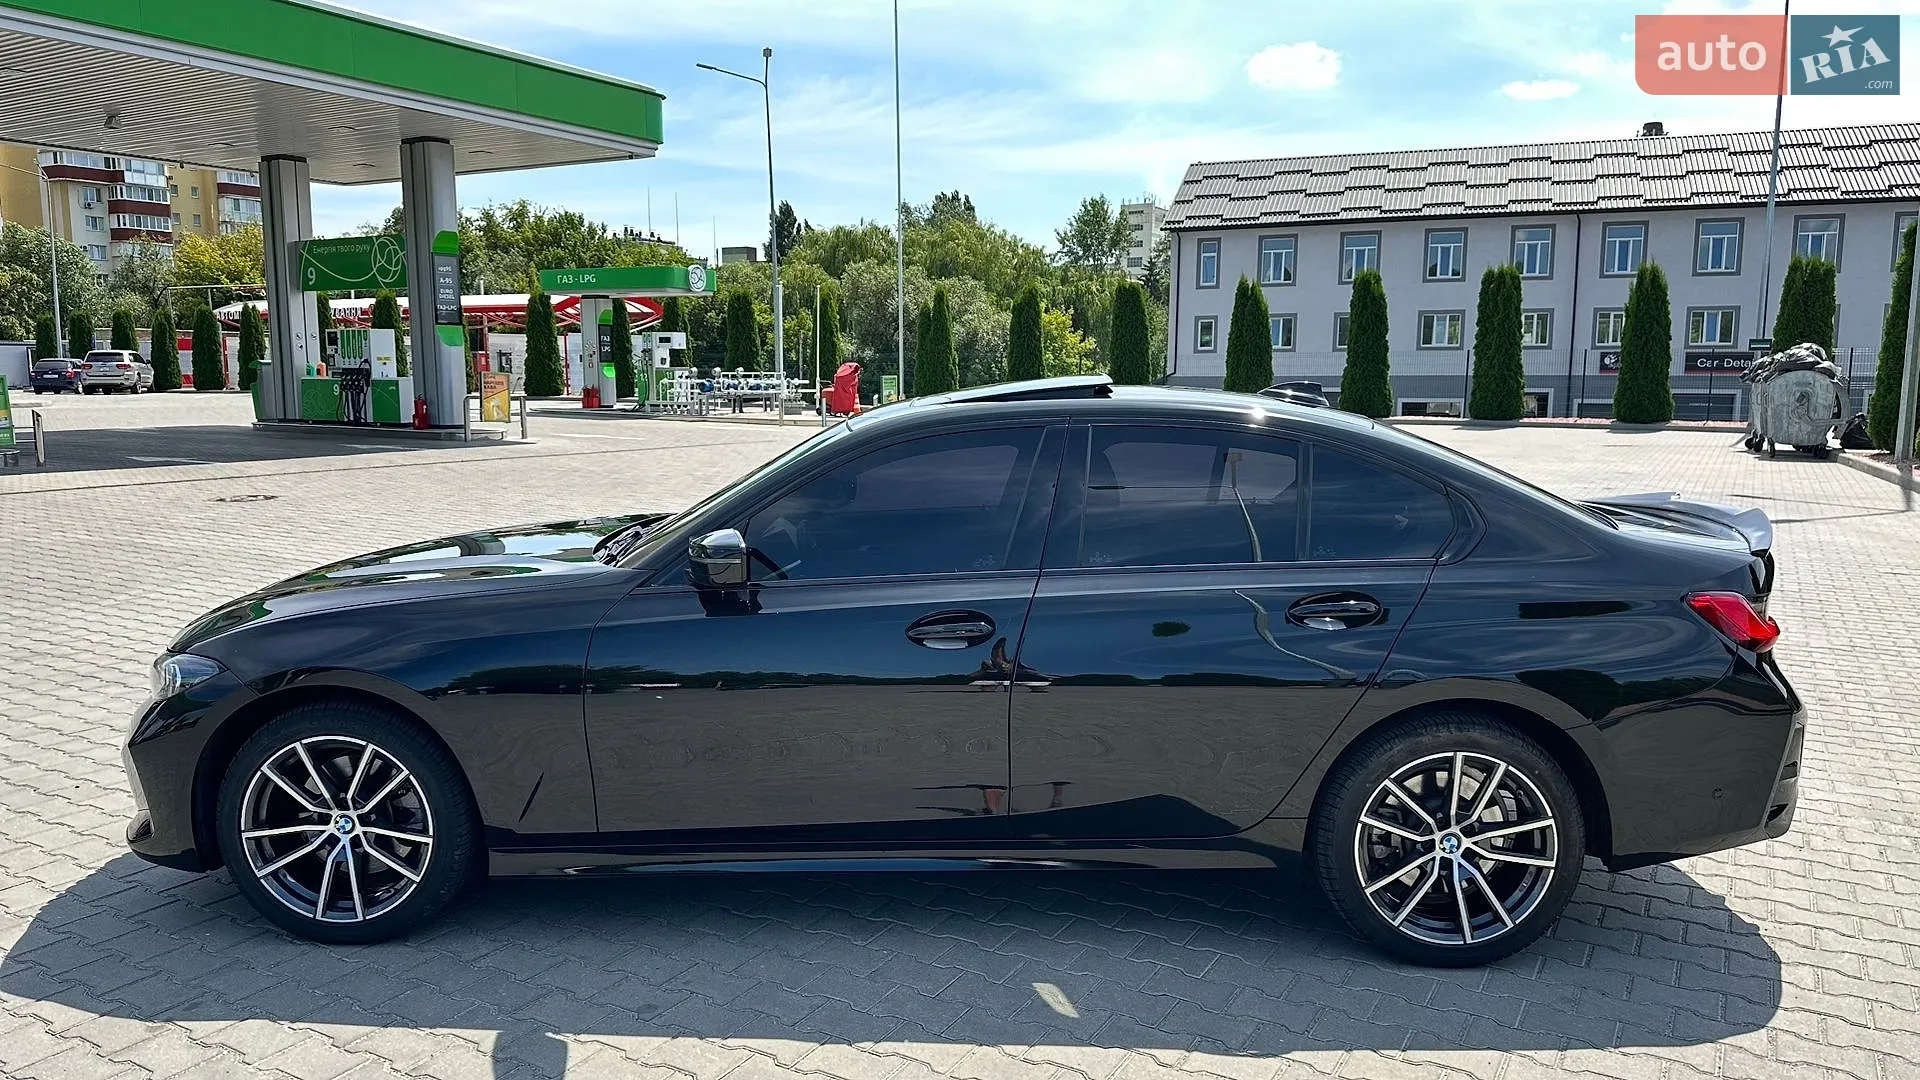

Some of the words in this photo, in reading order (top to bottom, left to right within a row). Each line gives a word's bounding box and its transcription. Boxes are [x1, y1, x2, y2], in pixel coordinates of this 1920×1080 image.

[307, 267, 316, 286] 9
[557, 275, 574, 284] ГАЗ
[579, 274, 596, 284] LPG
[1697, 358, 1719, 368] Car
[333, 384, 340, 396] 9
